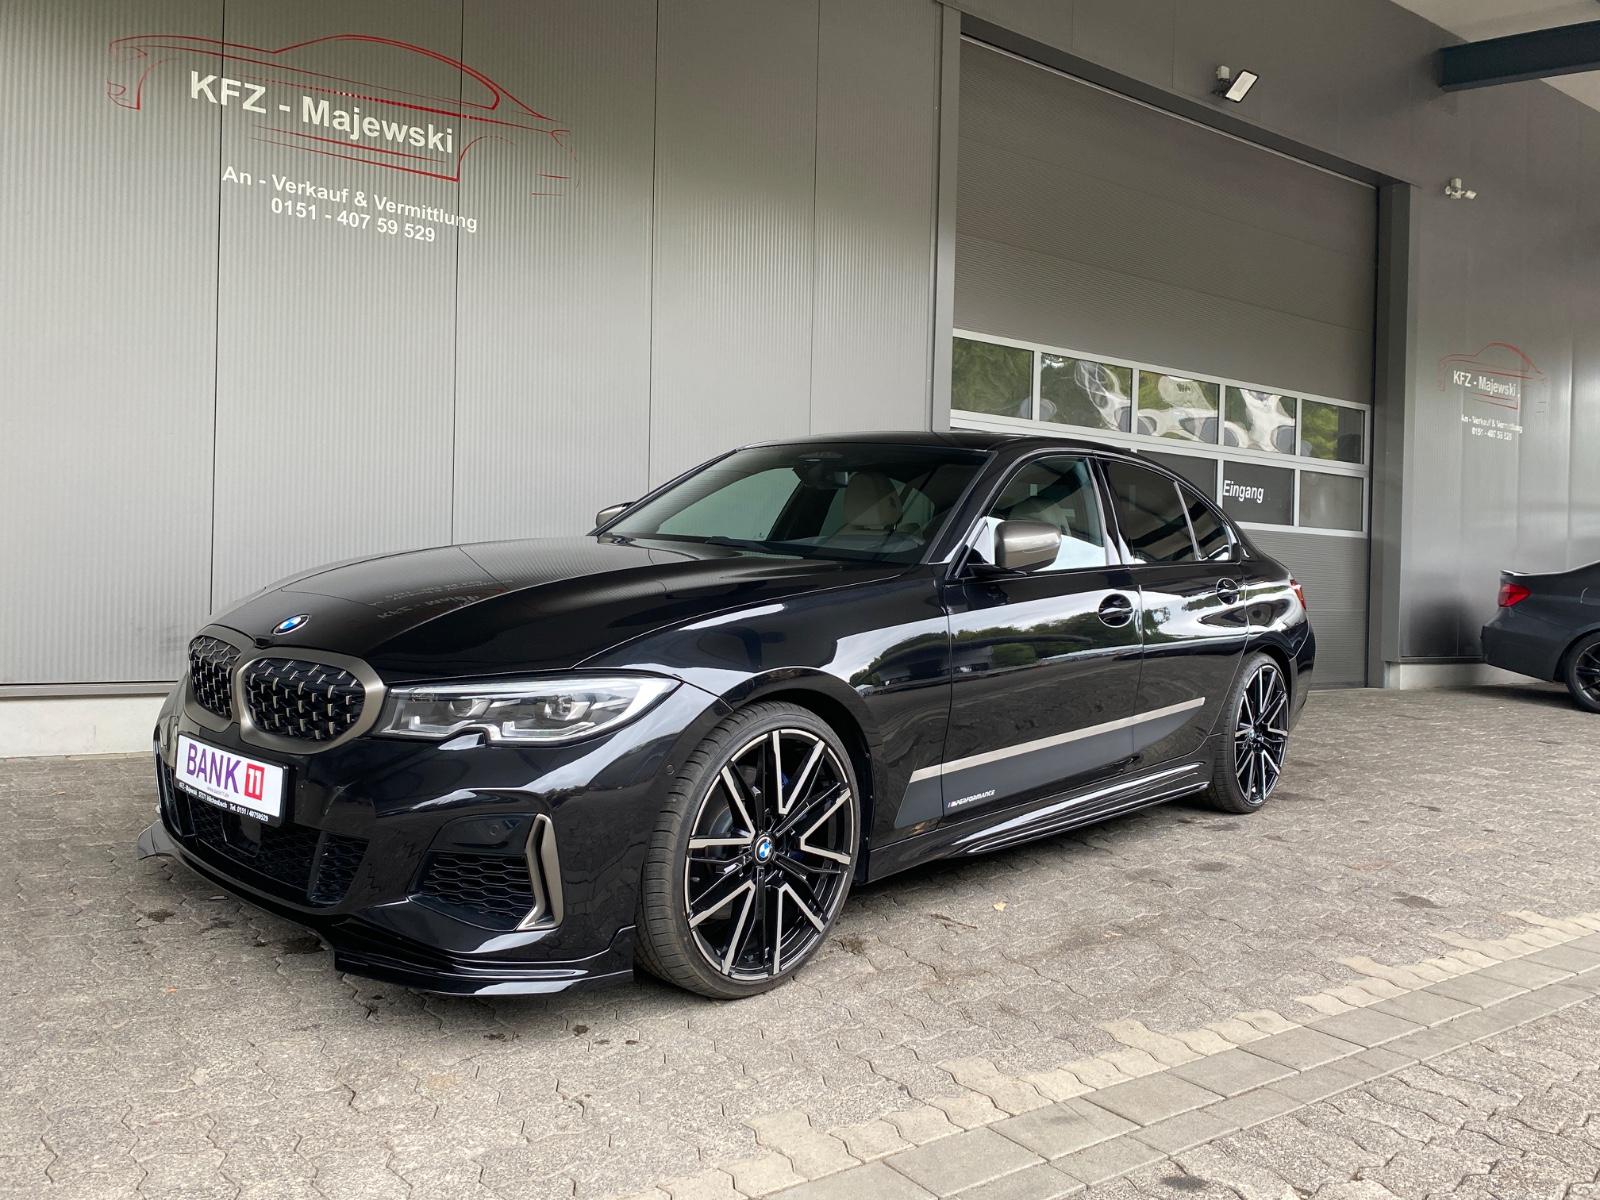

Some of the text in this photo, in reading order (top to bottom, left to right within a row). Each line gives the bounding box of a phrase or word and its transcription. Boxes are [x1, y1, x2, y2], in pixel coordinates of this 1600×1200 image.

[190, 70, 267, 114] KFZ
[302, 95, 453, 154] Majewski
[222, 166, 252, 186] An
[272, 174, 349, 204] Verkauf
[354, 191, 368, 208] &
[374, 194, 478, 234] Vermittlung
[271, 198, 317, 221] 0151
[336, 213, 371, 230] 407
[377, 217, 399, 235] 59
[404, 222, 436, 243] 529
[1453, 370, 1471, 387] KFZ
[1479, 376, 1516, 396] Majewski
[1223, 479, 1264, 503] Eingang
[187, 743, 240, 793] BANK
